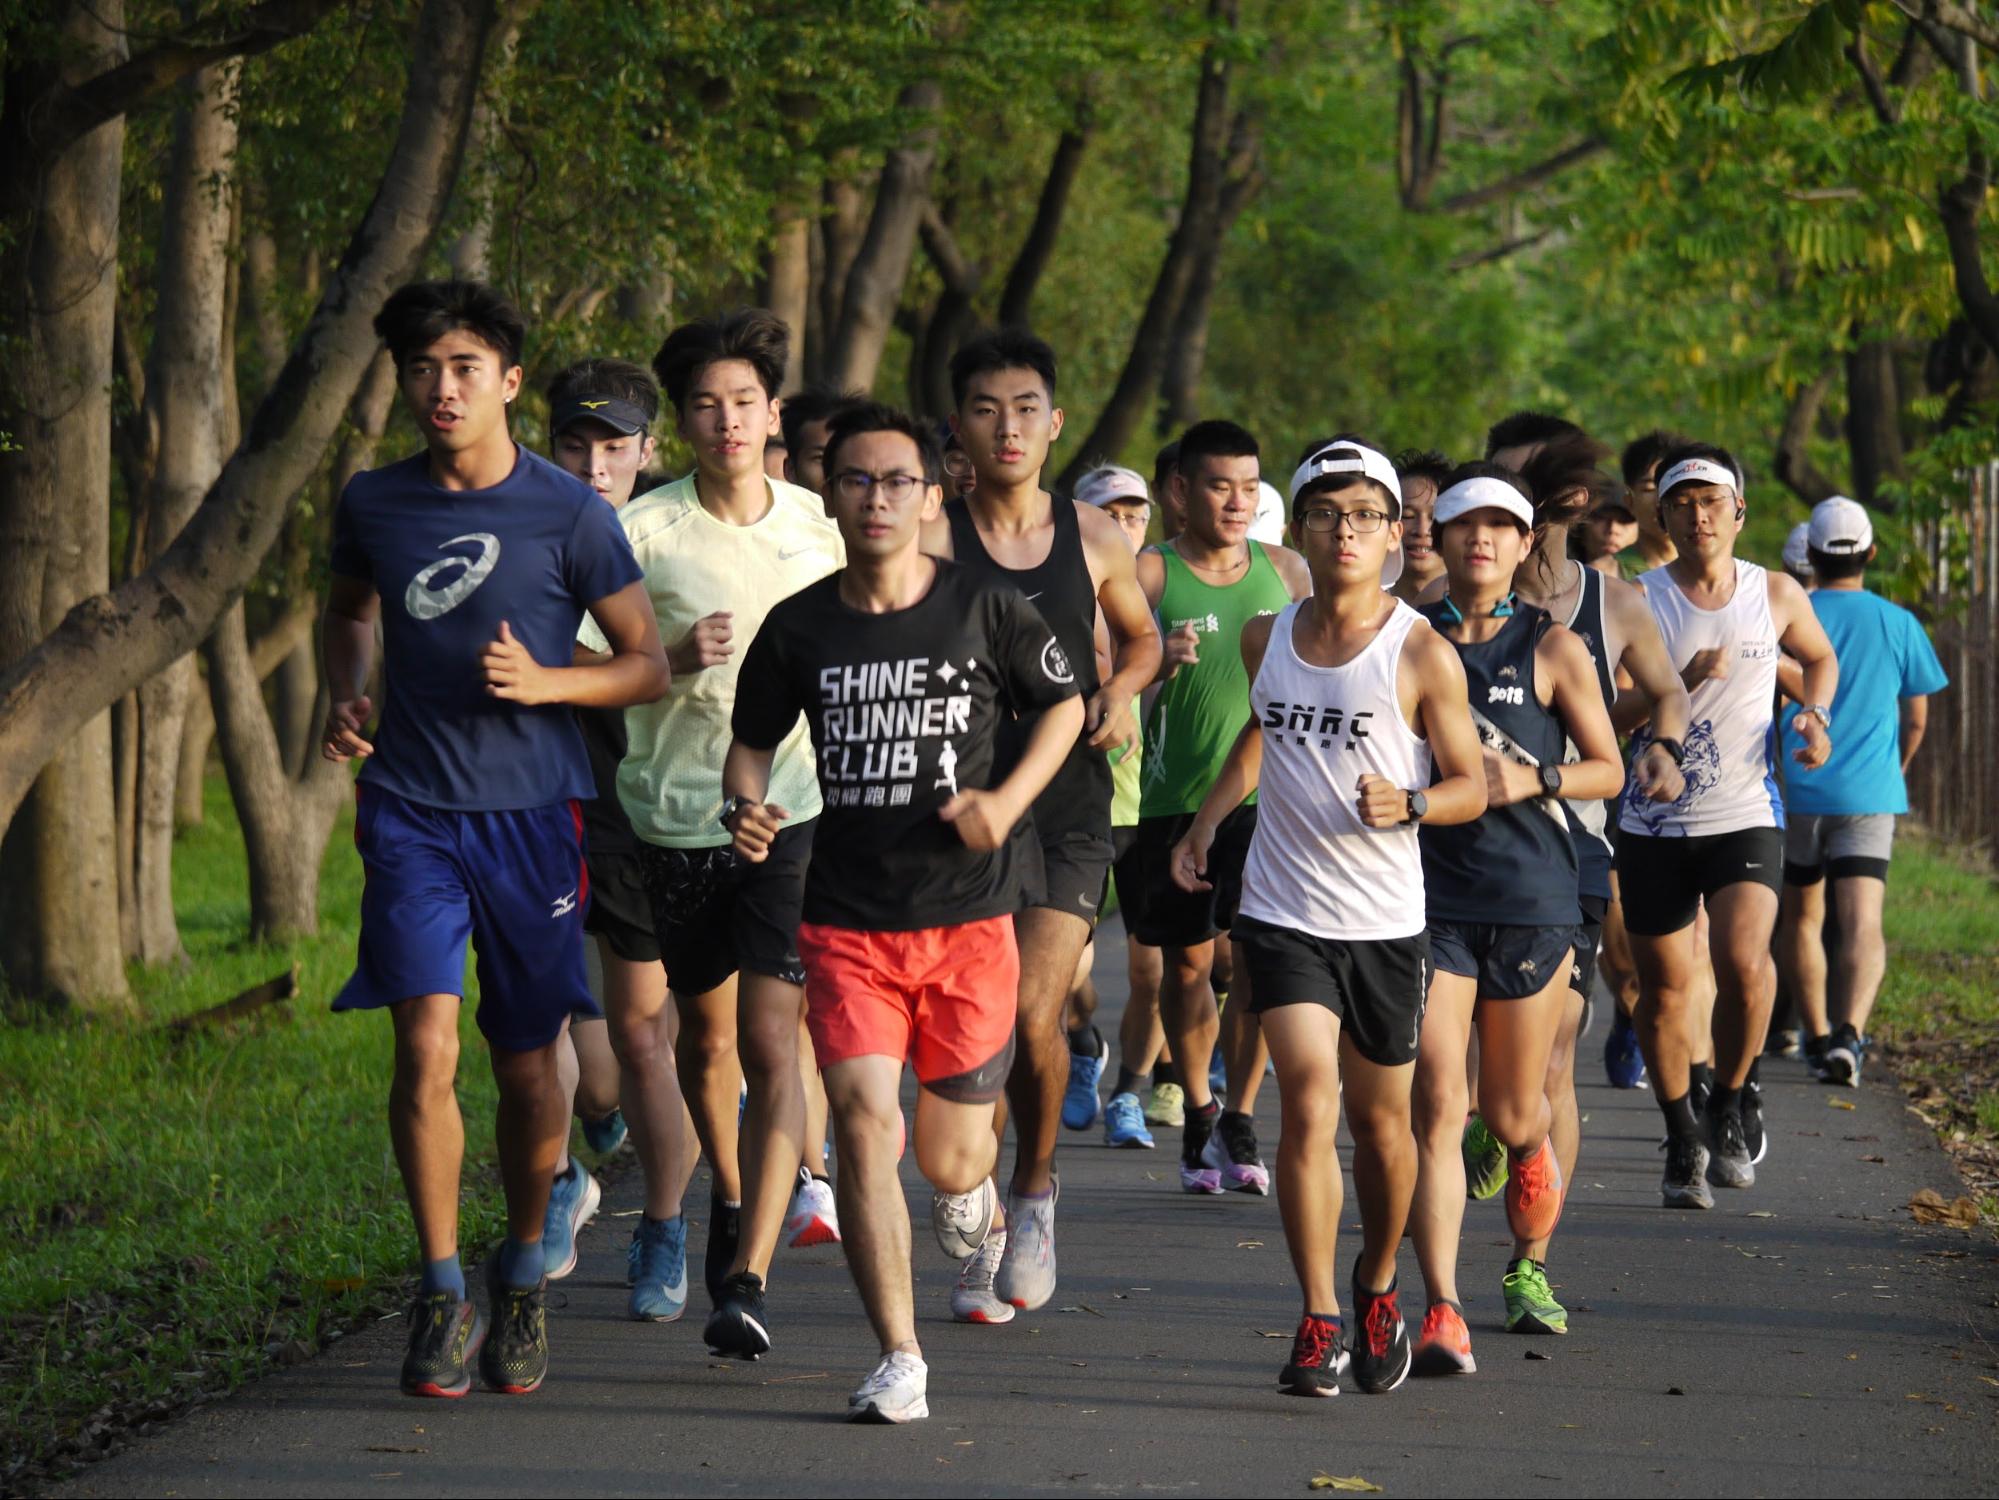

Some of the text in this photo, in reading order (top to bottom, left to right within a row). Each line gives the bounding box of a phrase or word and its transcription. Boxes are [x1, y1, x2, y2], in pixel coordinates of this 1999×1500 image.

[820, 657, 930, 705] SHINE
[1488, 685, 1524, 706] 2018
[823, 694, 972, 743] RUNNER
[1263, 701, 1374, 737] SNRC
[822, 740, 919, 782] CLUB
